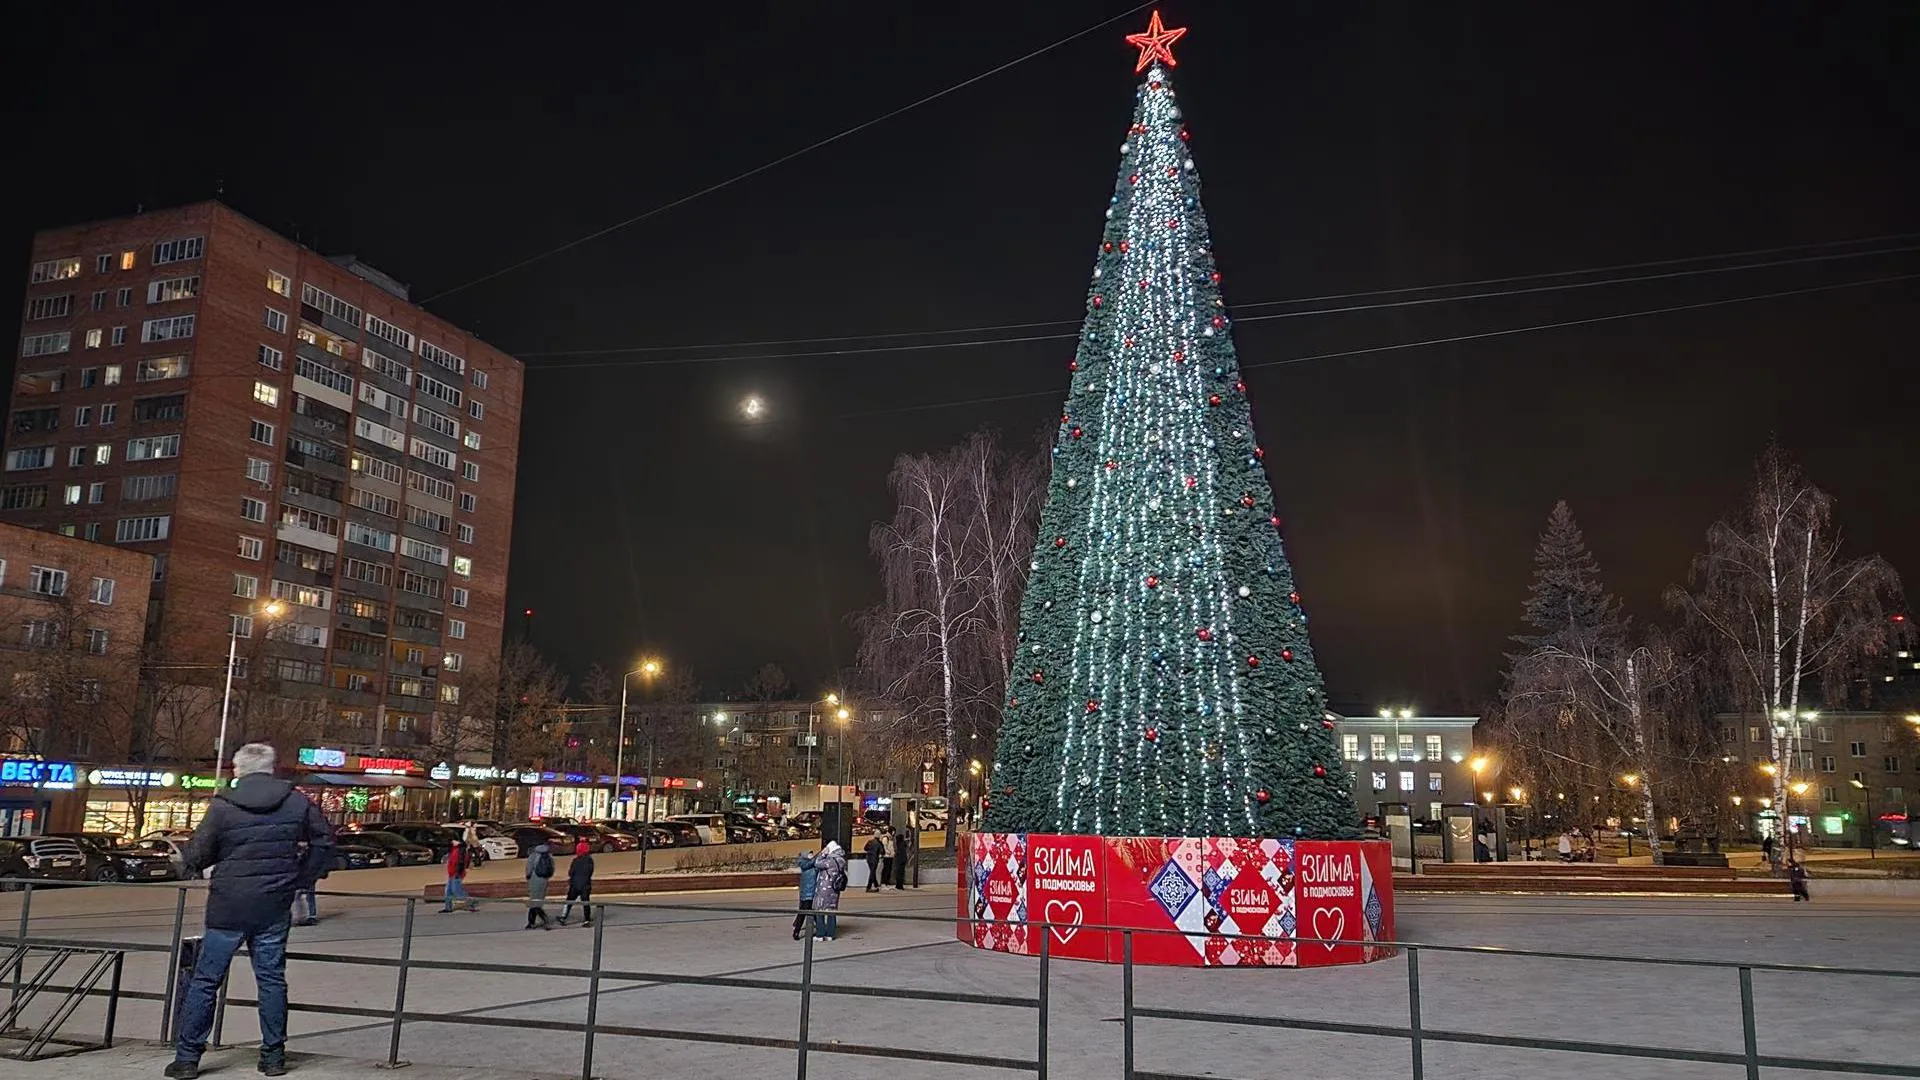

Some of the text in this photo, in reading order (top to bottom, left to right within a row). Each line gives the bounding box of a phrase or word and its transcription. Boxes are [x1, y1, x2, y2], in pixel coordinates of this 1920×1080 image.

[2, 761, 74, 781] ВЕСТА
[1034, 847, 1095, 877] ЗИМА
[1302, 853, 1354, 883] ЗИМА
[990, 880, 1012, 896] ЗИМА
[1231, 889, 1269, 905] ЗИМА
